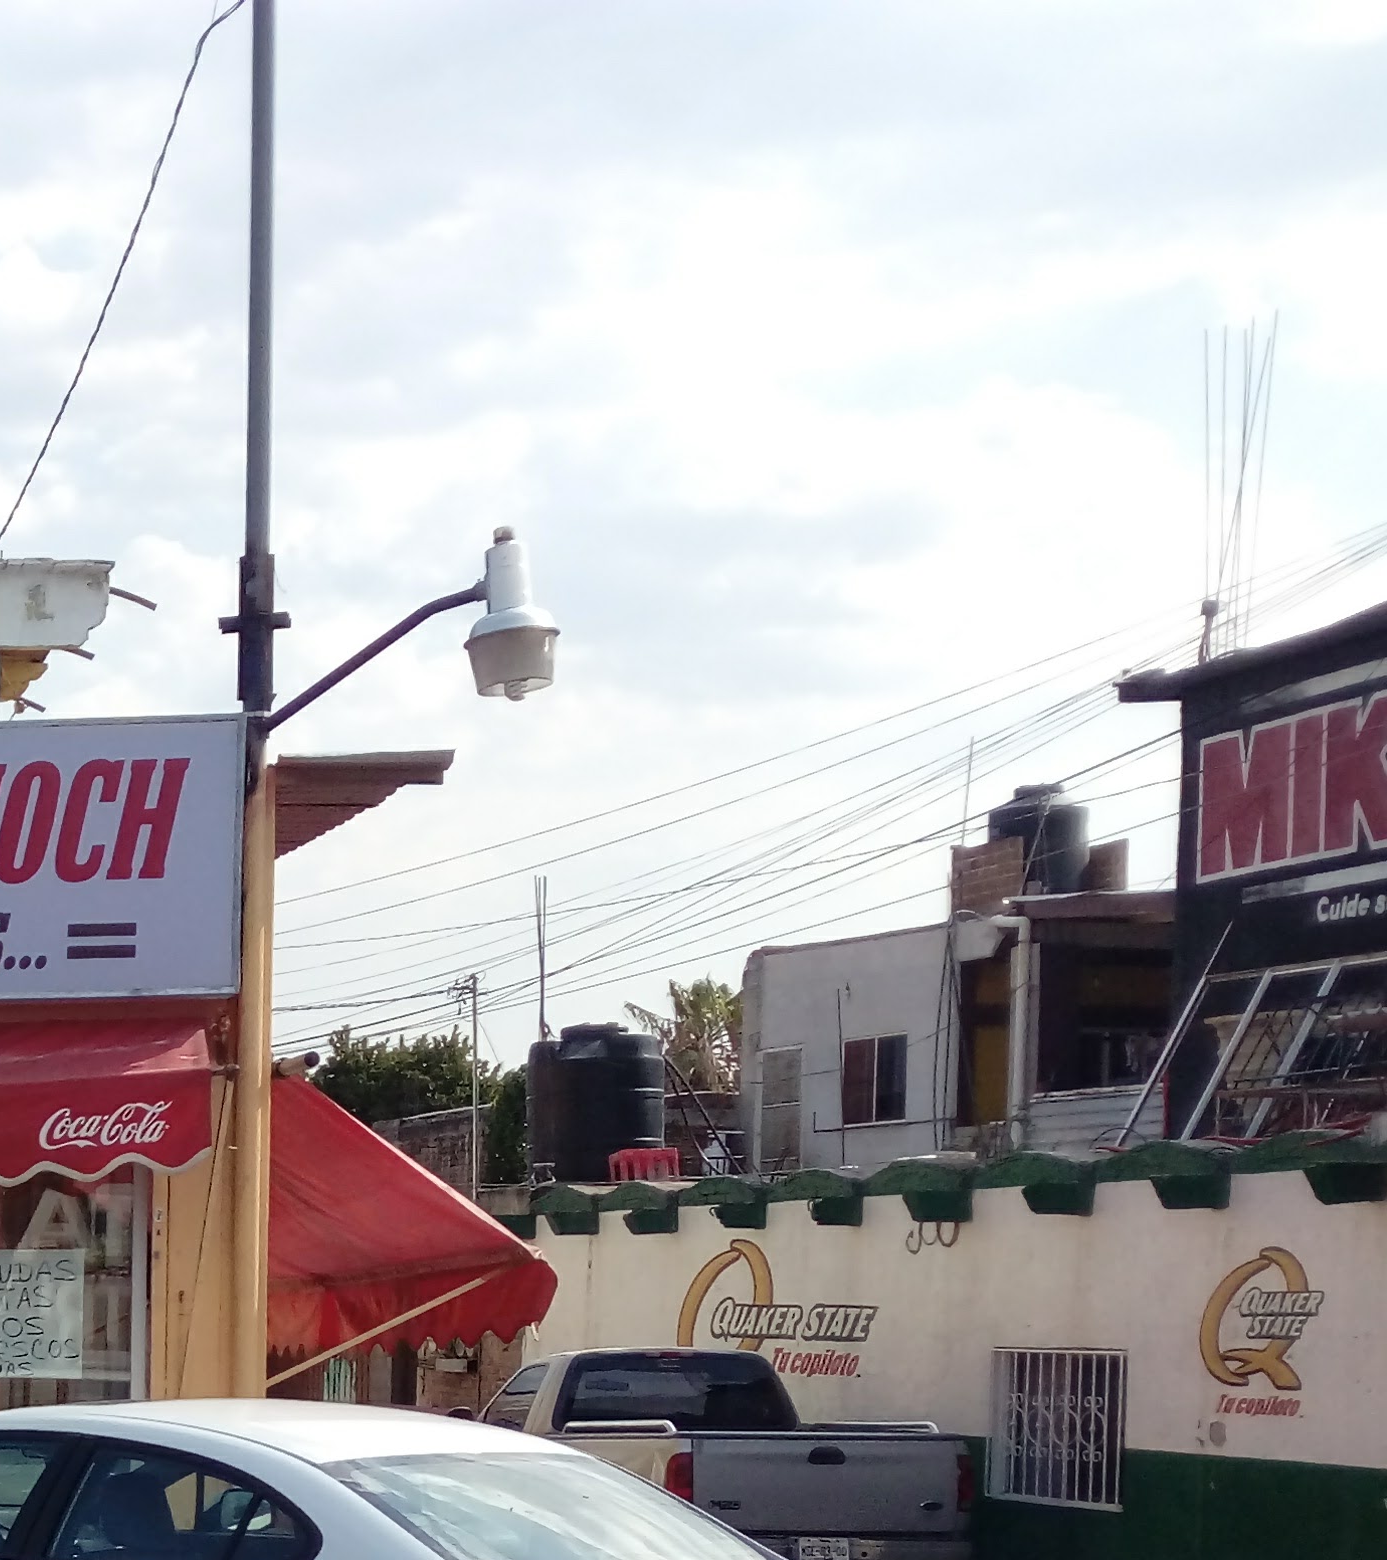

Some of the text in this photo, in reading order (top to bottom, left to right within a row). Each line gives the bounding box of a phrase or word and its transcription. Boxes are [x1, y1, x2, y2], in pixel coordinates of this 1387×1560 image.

[1316, 892, 1371, 922] Cuide
[38, 1100, 174, 1150] Coca-Cola
[1239, 1286, 1325, 1316] QUAKER
[710, 1297, 880, 1342] QUAKER STATE
[1246, 1315, 1307, 1340] STATE
